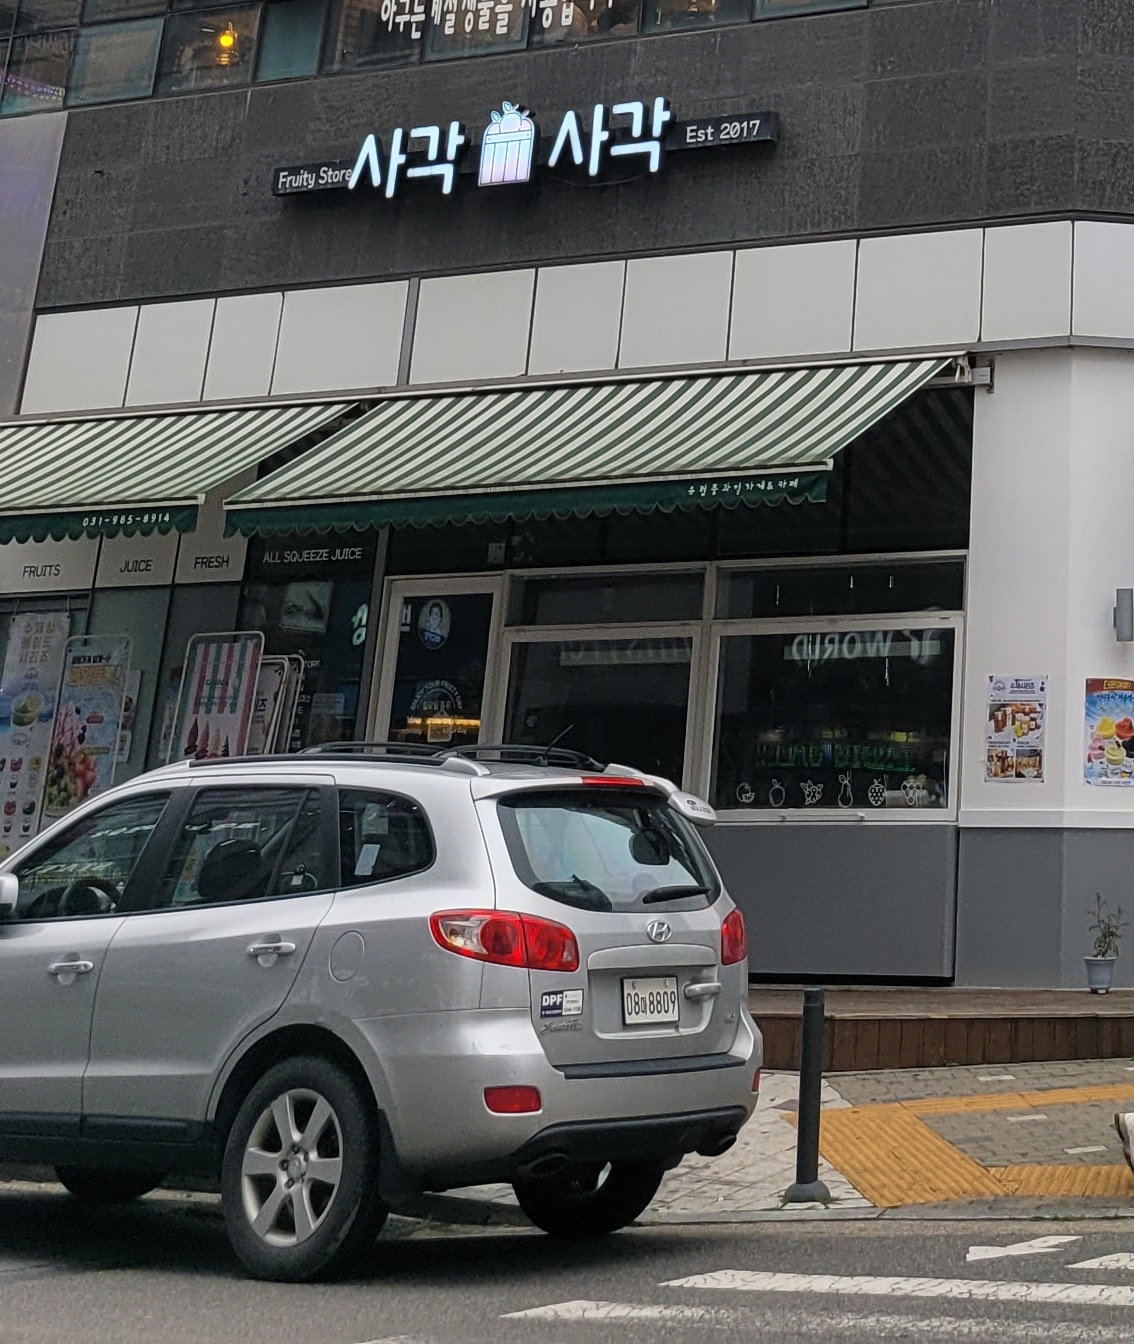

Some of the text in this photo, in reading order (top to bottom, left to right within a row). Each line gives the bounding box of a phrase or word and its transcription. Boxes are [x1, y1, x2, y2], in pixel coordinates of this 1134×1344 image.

[278, 96, 761, 199] Fruity Store 사각 사각 Est 2017
[83, 512, 171, 527] 031-985-8914
[194, 554, 230, 570] FRESH
[263, 547, 363, 564] ALL SQUEEZE JUICE
[22, 563, 62, 578] FRUITS
[119, 559, 152, 574] JUICE
[542, 994, 564, 1008] DPF
